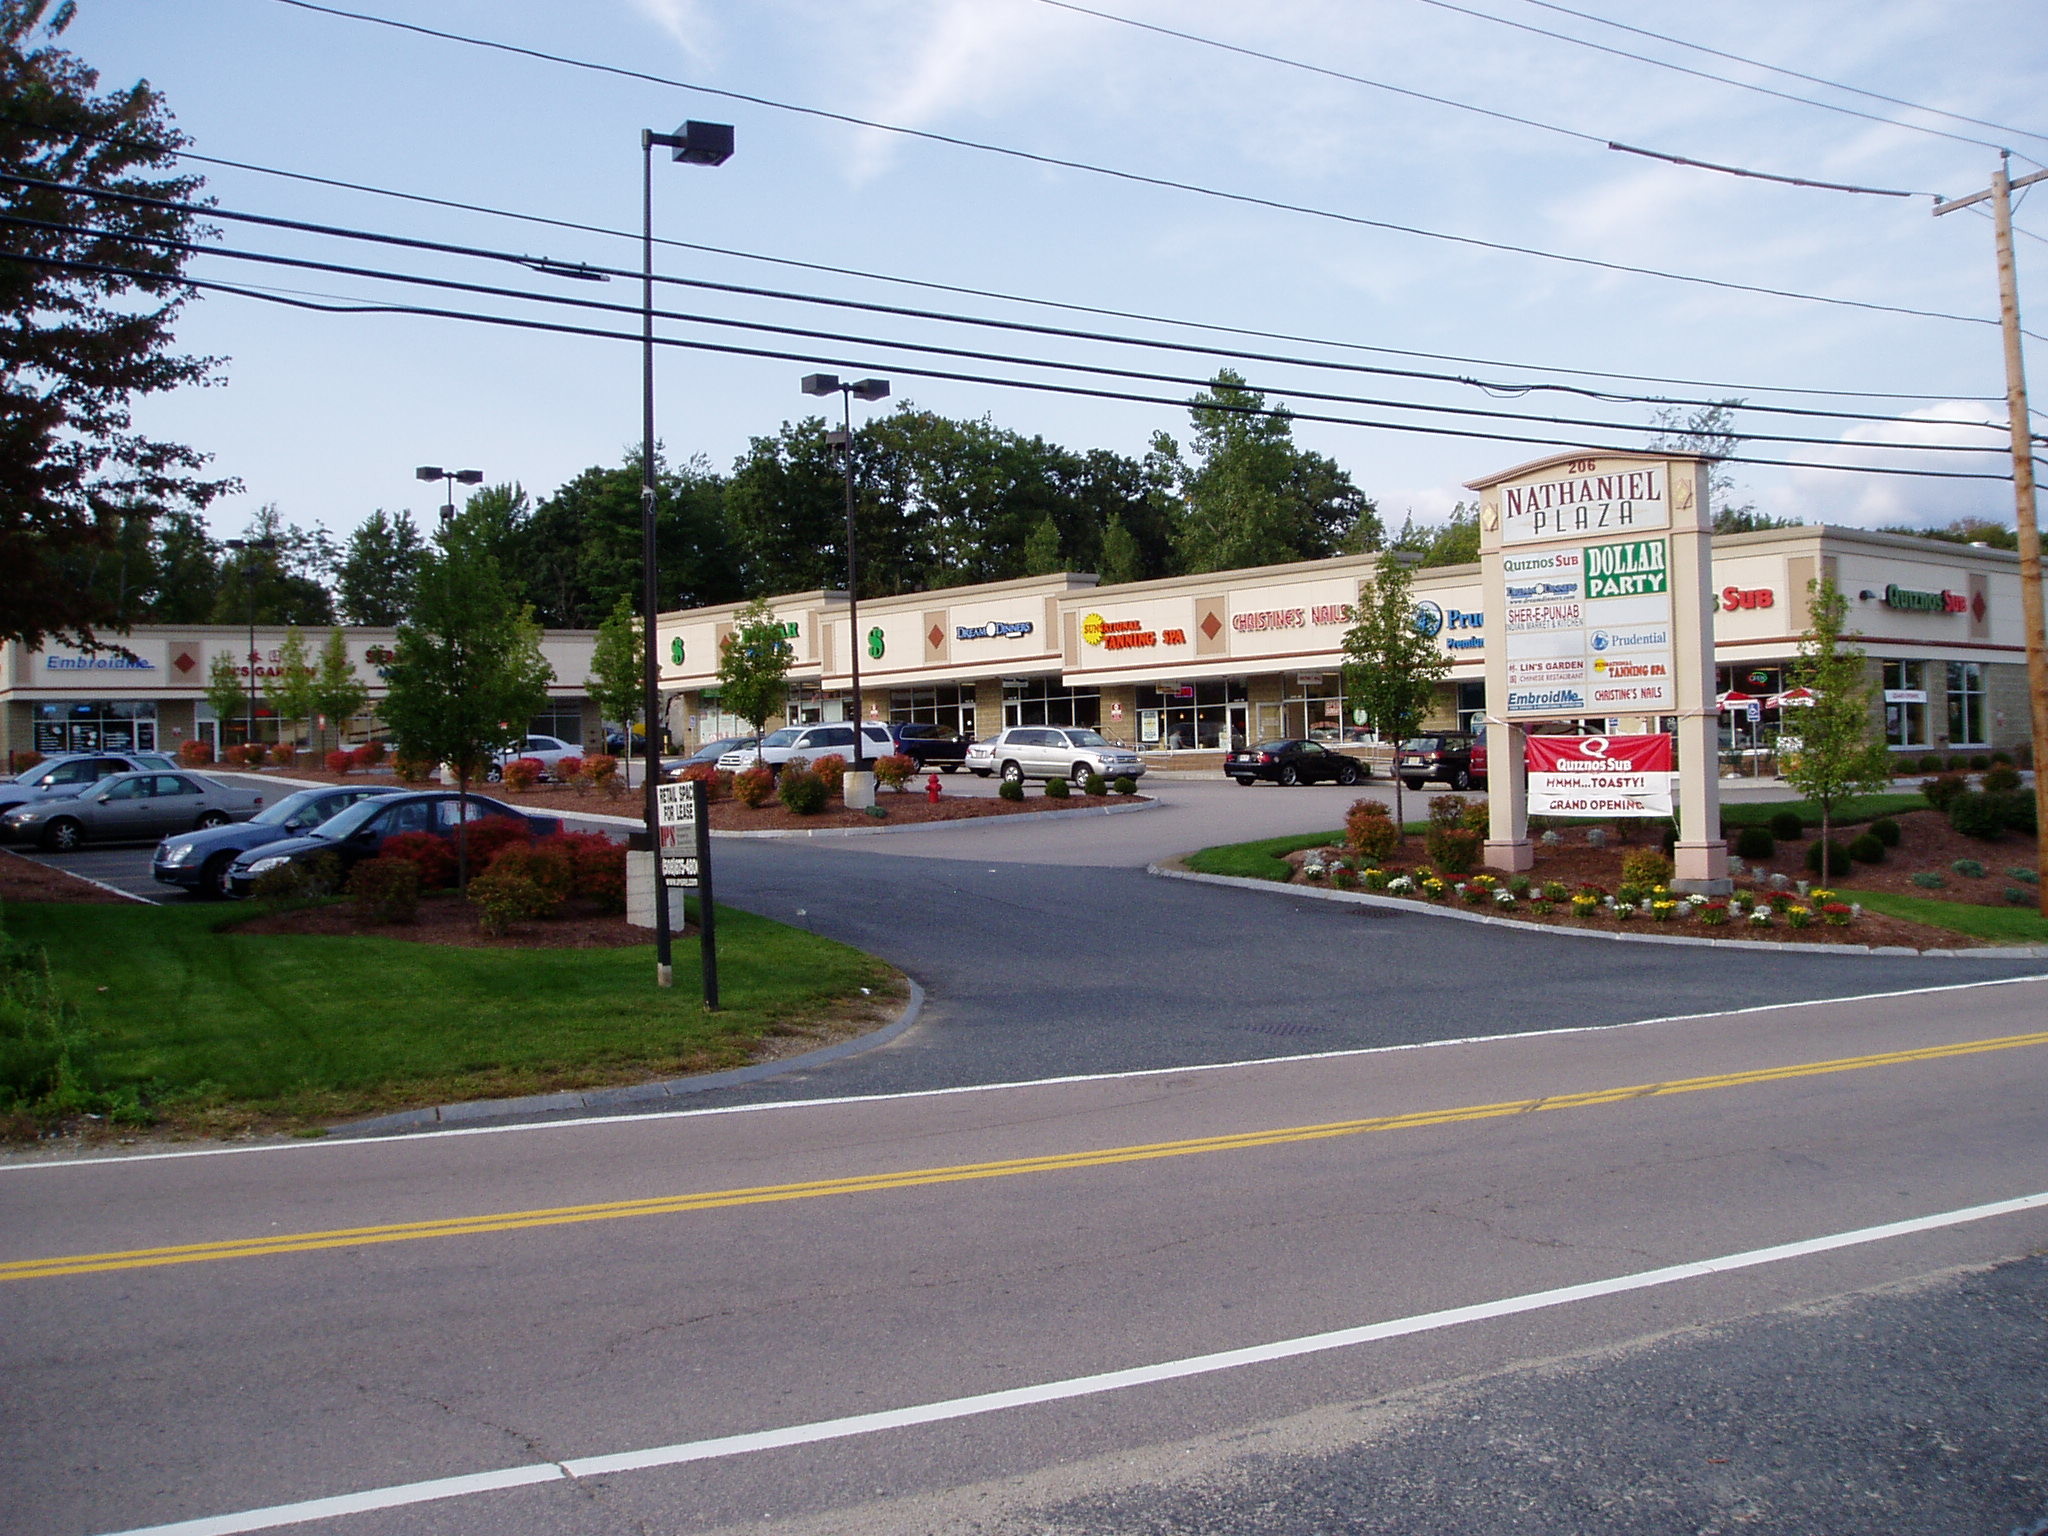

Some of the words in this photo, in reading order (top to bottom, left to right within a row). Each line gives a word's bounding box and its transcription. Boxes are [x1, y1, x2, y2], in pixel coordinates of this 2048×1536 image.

[1568, 459, 1597, 475] 206
[1506, 471, 1662, 519] NATHANIEL
[1534, 500, 1634, 535] PLAZA
[1555, 554, 1579, 568] SUB
[1588, 541, 1665, 577] DOLLAR
[1590, 573, 1664, 598] PARTY
[1722, 586, 1774, 612] SUB
[1885, 583, 1943, 612] QUIZNOS
[1942, 588, 1969, 613] SUB
[1232, 607, 1304, 632] CHRISTINE'S
[1311, 603, 1350, 625] NAILS
[1508, 604, 1580, 624] SHER-E-PUNJAB
[956, 625, 987, 641] DREAM
[995, 620, 1033, 638] DINNERS
[1104, 631, 1157, 651] TANNING
[1162, 628, 1186, 646] SPA
[1612, 631, 1667, 647] Prudential
[1520, 662, 1544, 672] LIN'S
[1545, 660, 1584, 671] GARDEN
[1608, 665, 1649, 678] TANNING
[1650, 663, 1667, 675] SPA
[1508, 689, 1584, 705] EmbroidMe
[1594, 688, 1638, 701] CHRISTINE'S
[1640, 686, 1663, 699] NAILS
[1556, 759, 1606, 772] QUIZNOS
[1606, 757, 1632, 771] SUB
[1549, 799, 1588, 811] GRAND
[1589, 799, 1645, 811] OPENING
